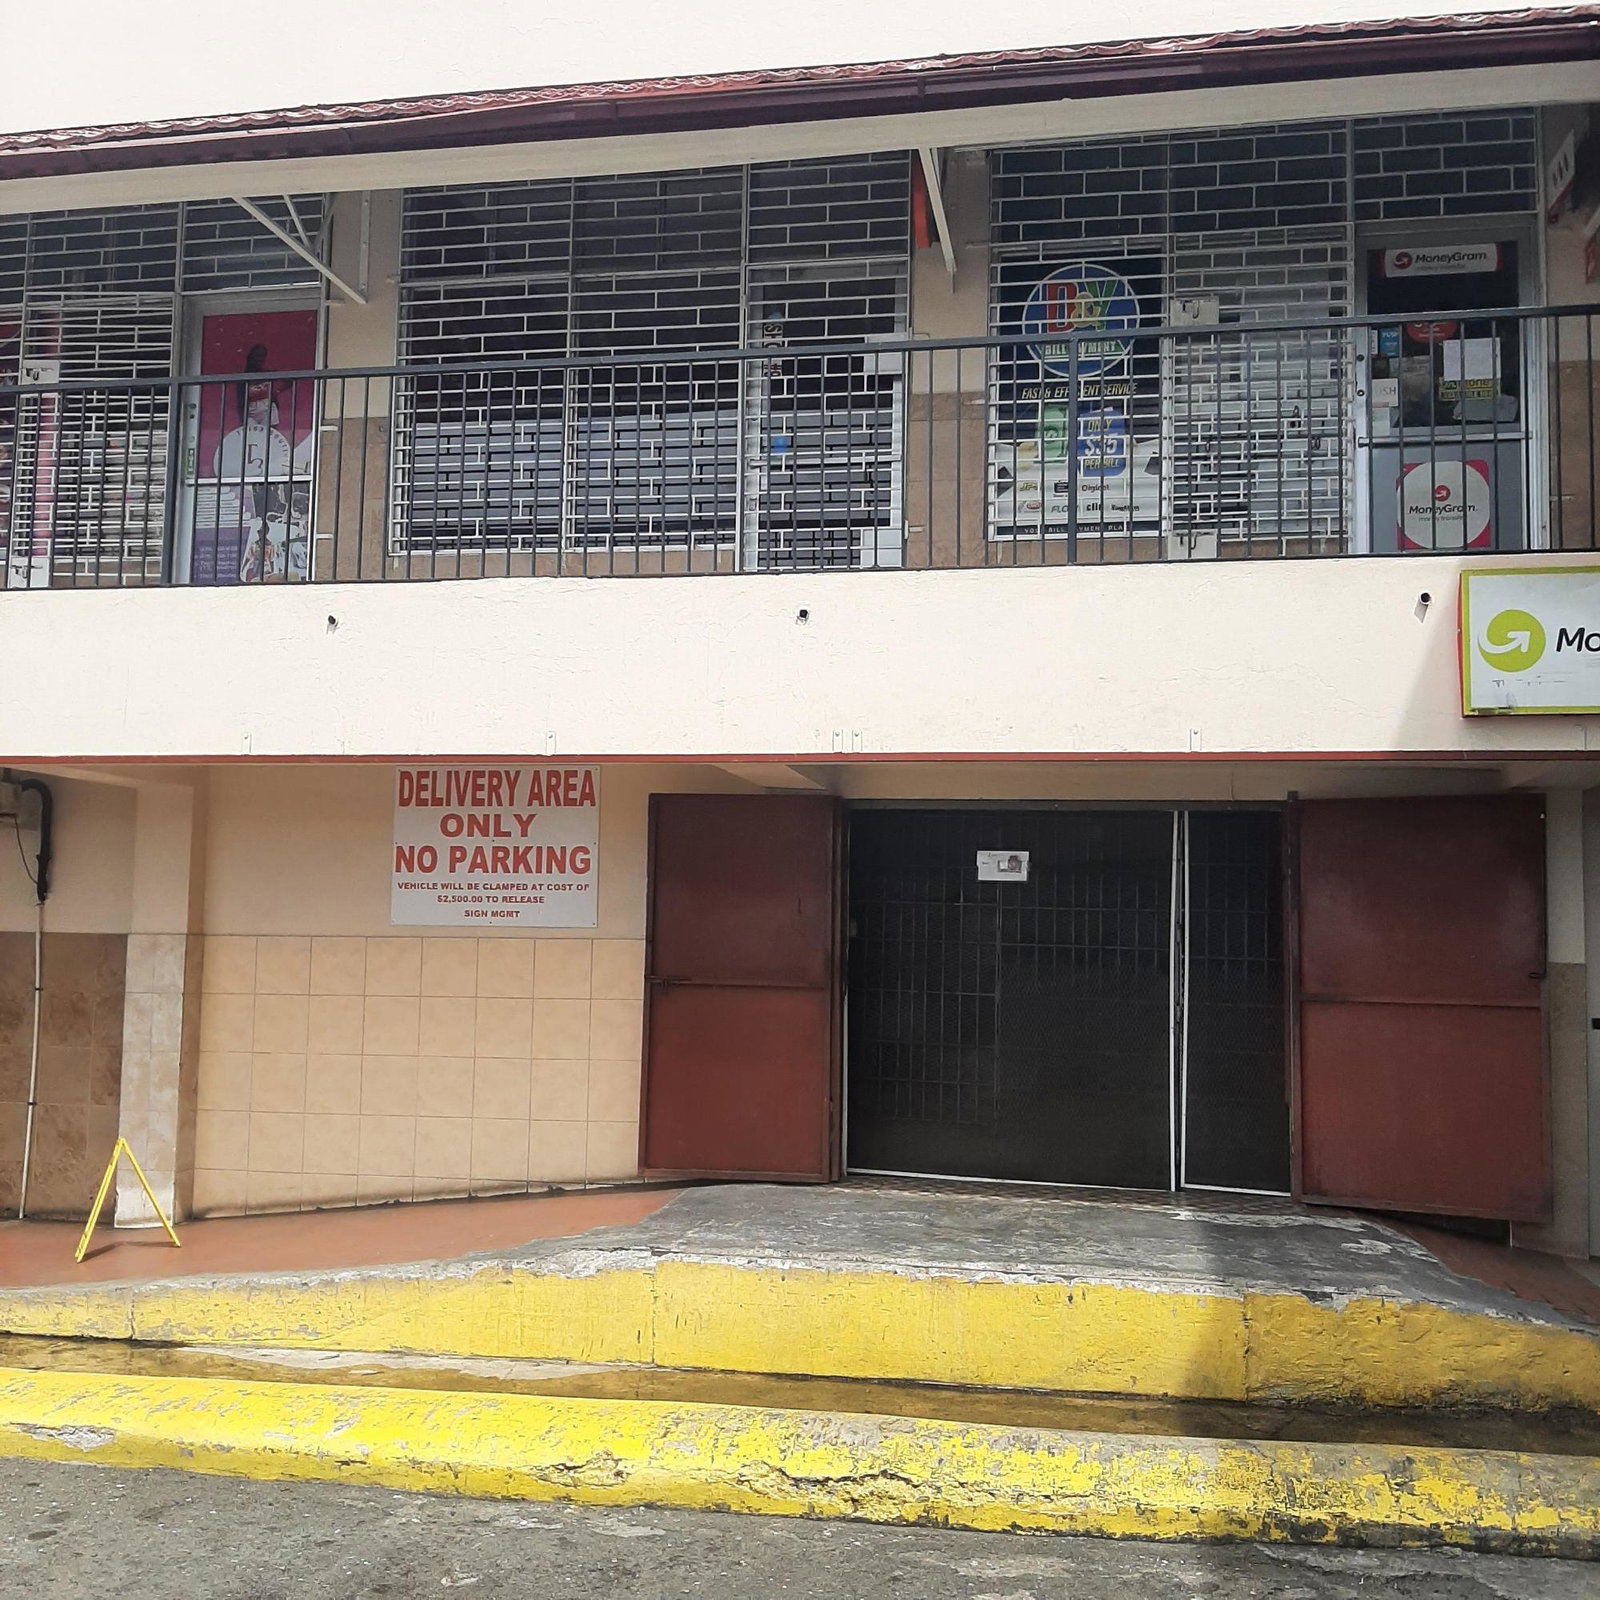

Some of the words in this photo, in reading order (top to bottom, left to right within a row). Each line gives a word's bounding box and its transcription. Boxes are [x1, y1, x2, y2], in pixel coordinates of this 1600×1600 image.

[1415, 252, 1487, 264] MoneyGram
[399, 770, 521, 807] DELIVERY
[528, 770, 596, 807] AREA
[440, 813, 537, 838] ONLY
[395, 845, 438, 873] NO
[449, 845, 591, 875] PARKING
[398, 882, 438, 890] VEHICLE
[483, 883, 528, 891] CLAMPED
[502, 896, 545, 904] RELEASE
